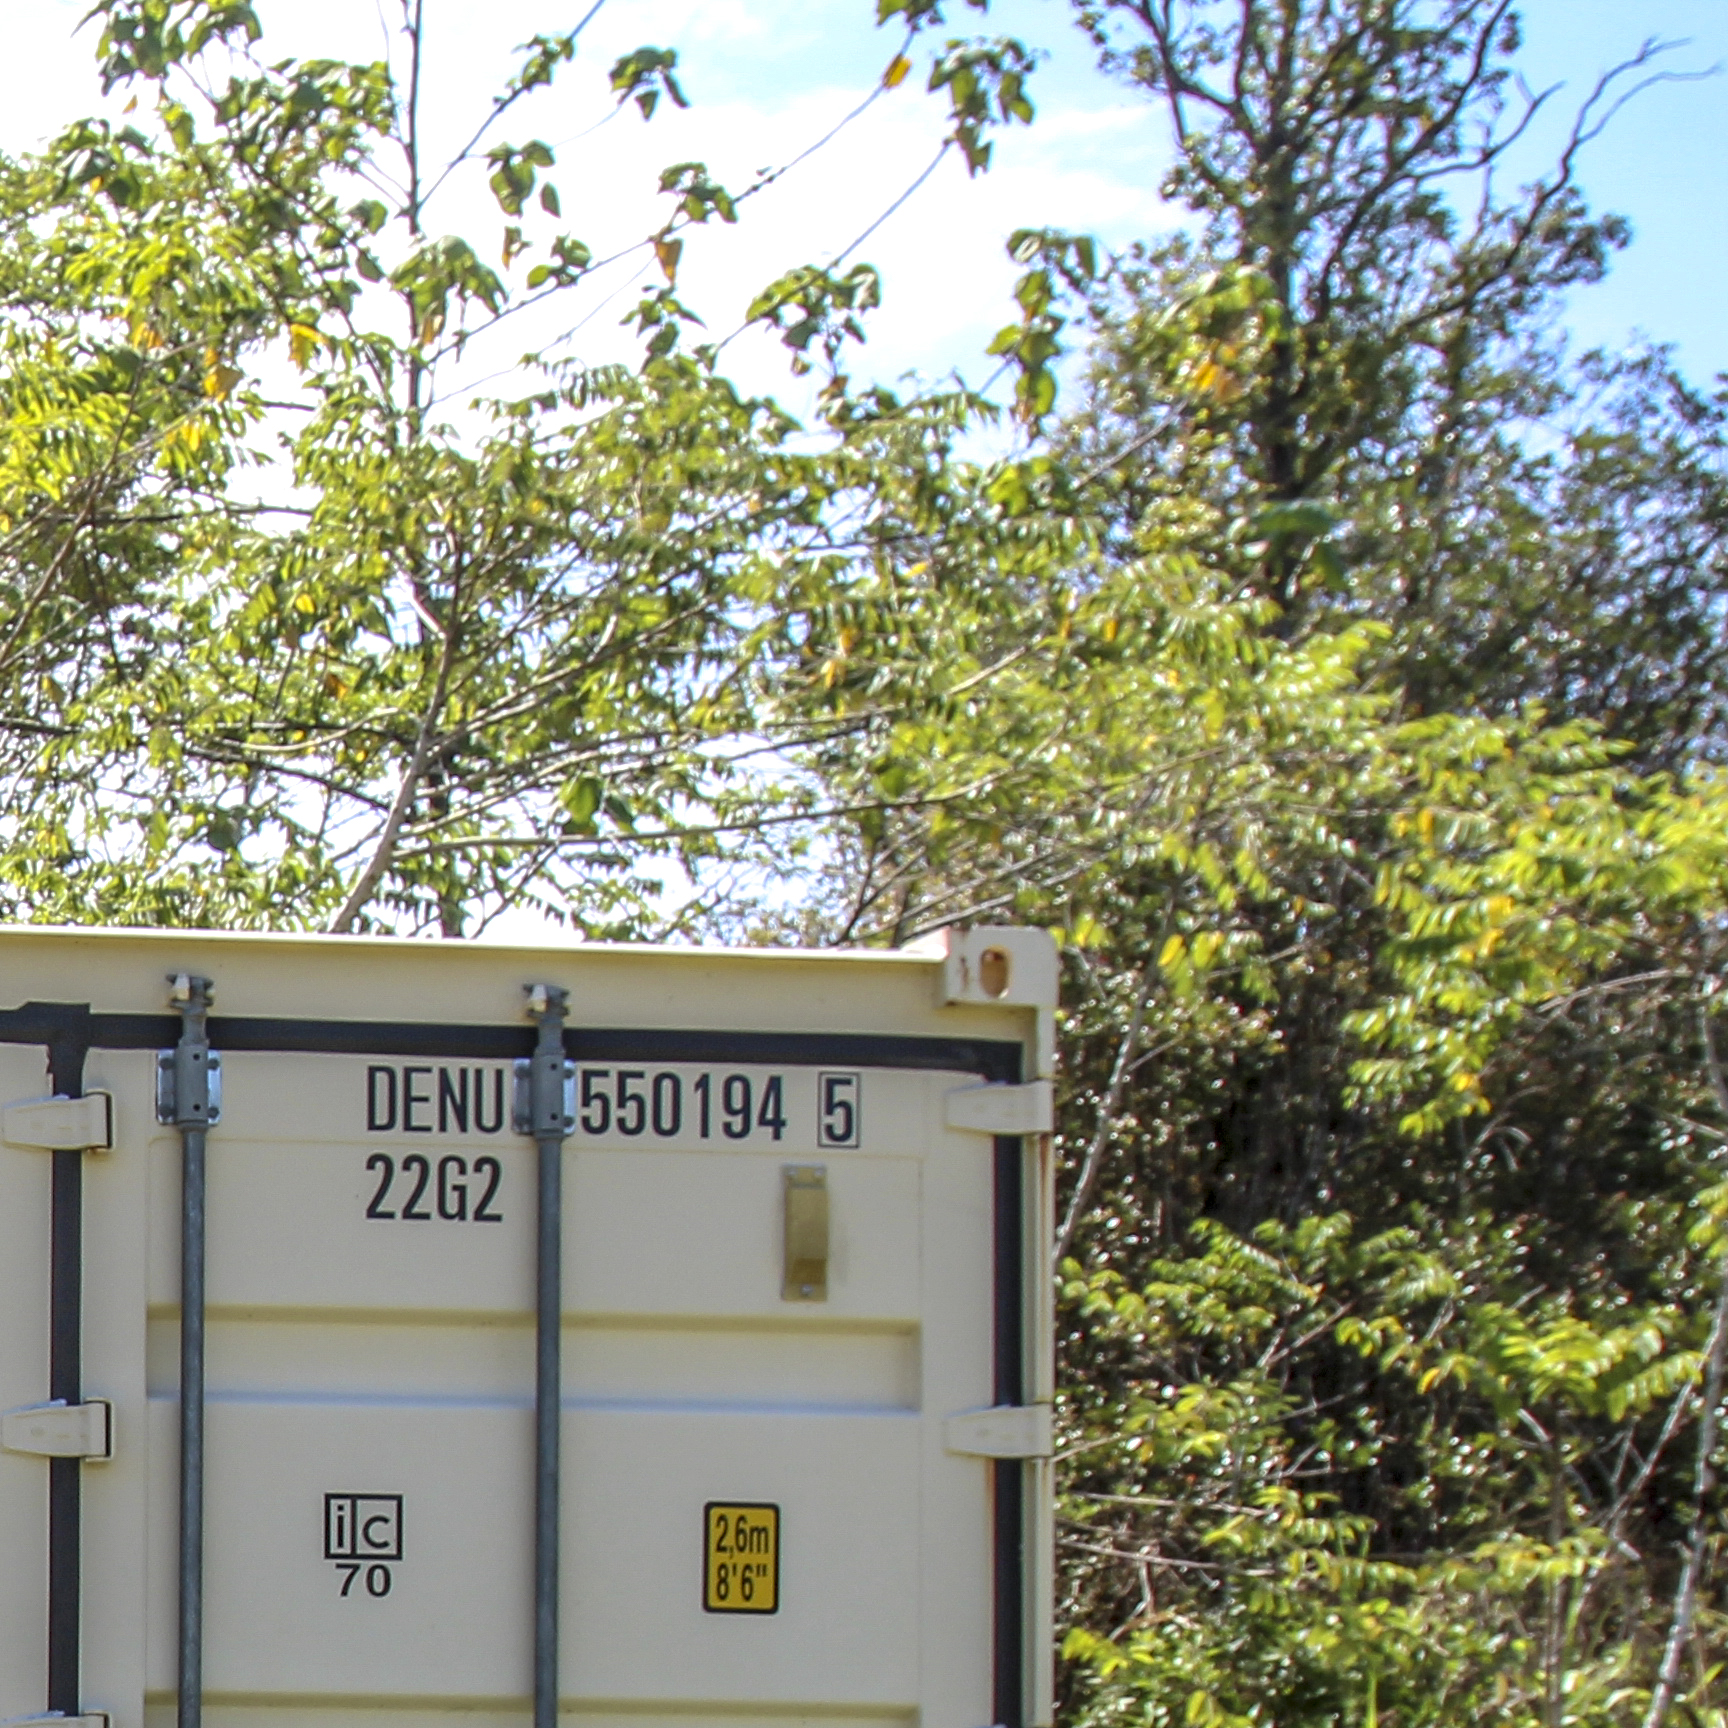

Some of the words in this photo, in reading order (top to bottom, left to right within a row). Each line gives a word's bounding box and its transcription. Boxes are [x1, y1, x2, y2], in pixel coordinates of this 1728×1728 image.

[366, 1064, 504, 1134] DENU
[580, 1068, 787, 1142] 550194
[822, 1076, 856, 1142] 5
[365, 1152, 504, 1222] 22G2
[715, 1513, 770, 1560] 2,6m
[335, 1562, 392, 1598] 70
[715, 1562, 768, 1602] 8'6"
